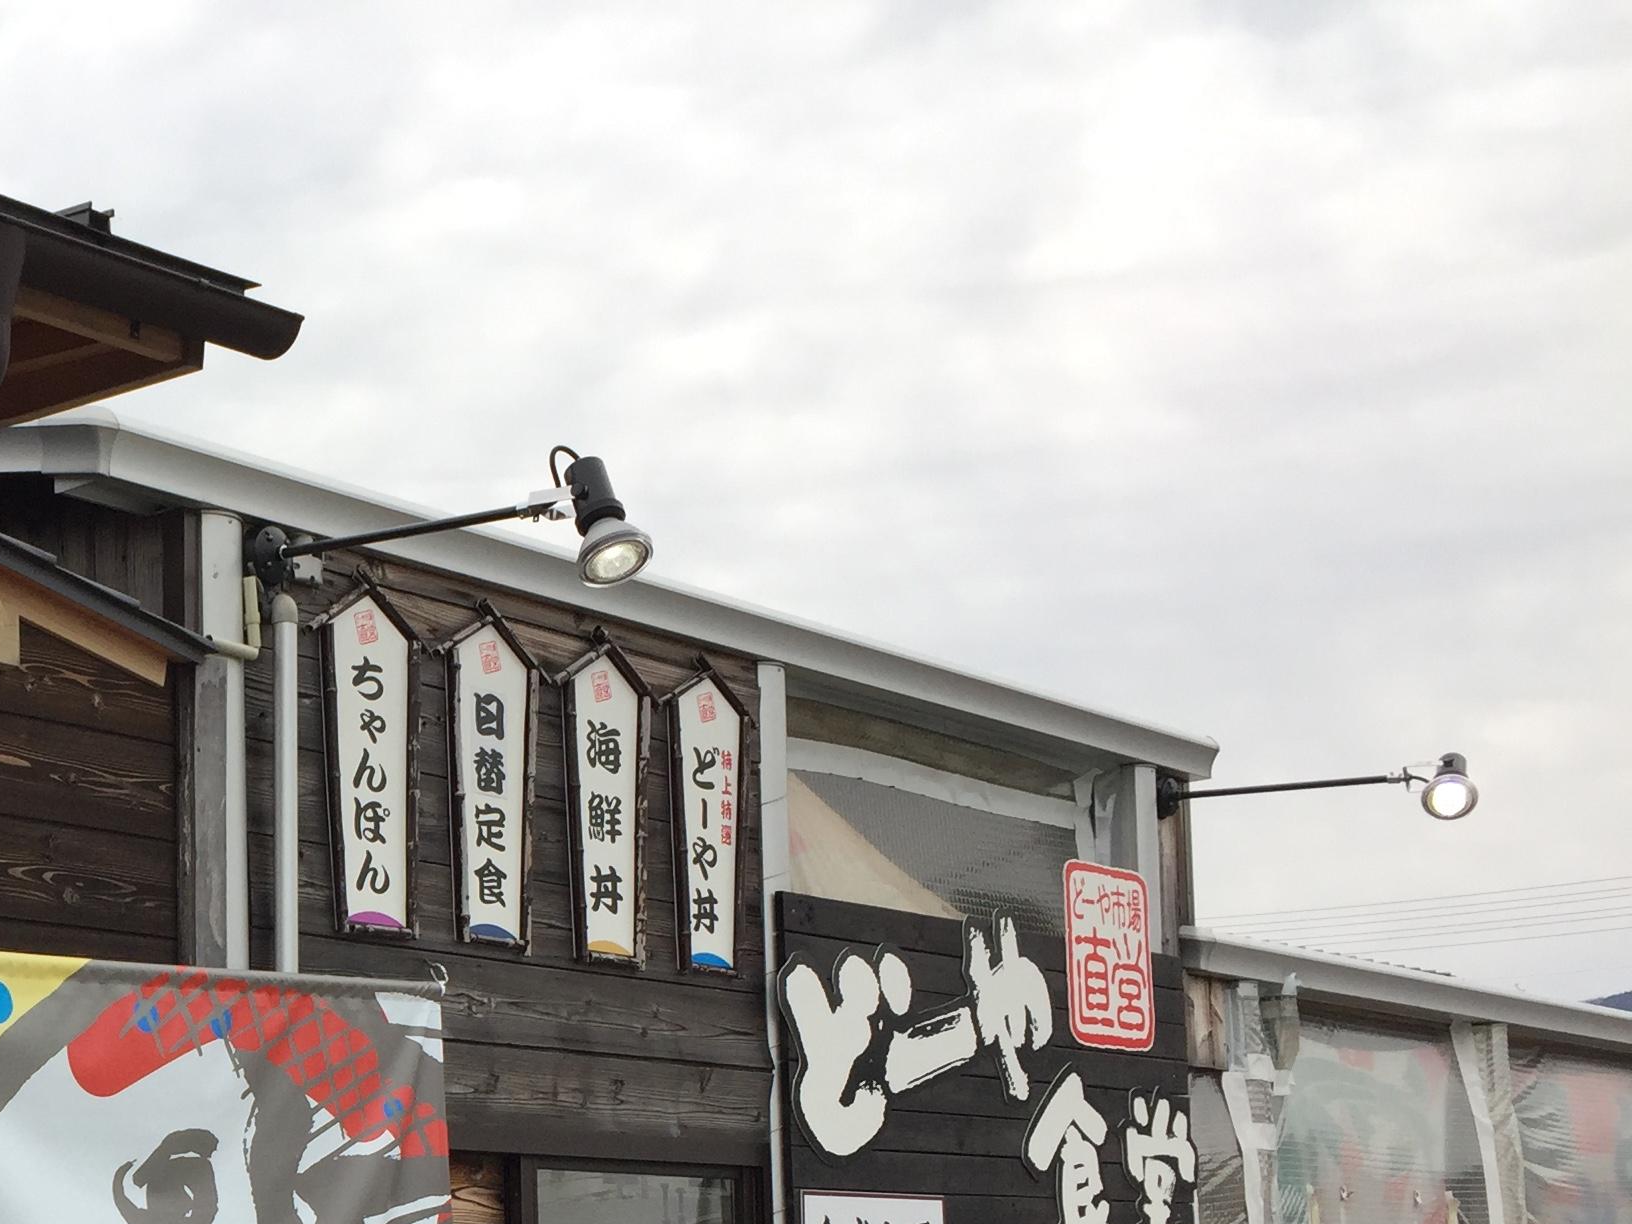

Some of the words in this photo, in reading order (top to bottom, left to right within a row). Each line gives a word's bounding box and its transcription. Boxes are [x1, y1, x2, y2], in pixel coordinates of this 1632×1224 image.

[351, 656, 390, 895] ちゃんぽん
[473, 692, 506, 908] 日替定食
[586, 720, 624, 914] 海鮮丼
[692, 746, 719, 934] どーや丼
[1073, 876, 1142, 934] どーや市場
[1074, 926, 1147, 1033] 直営
